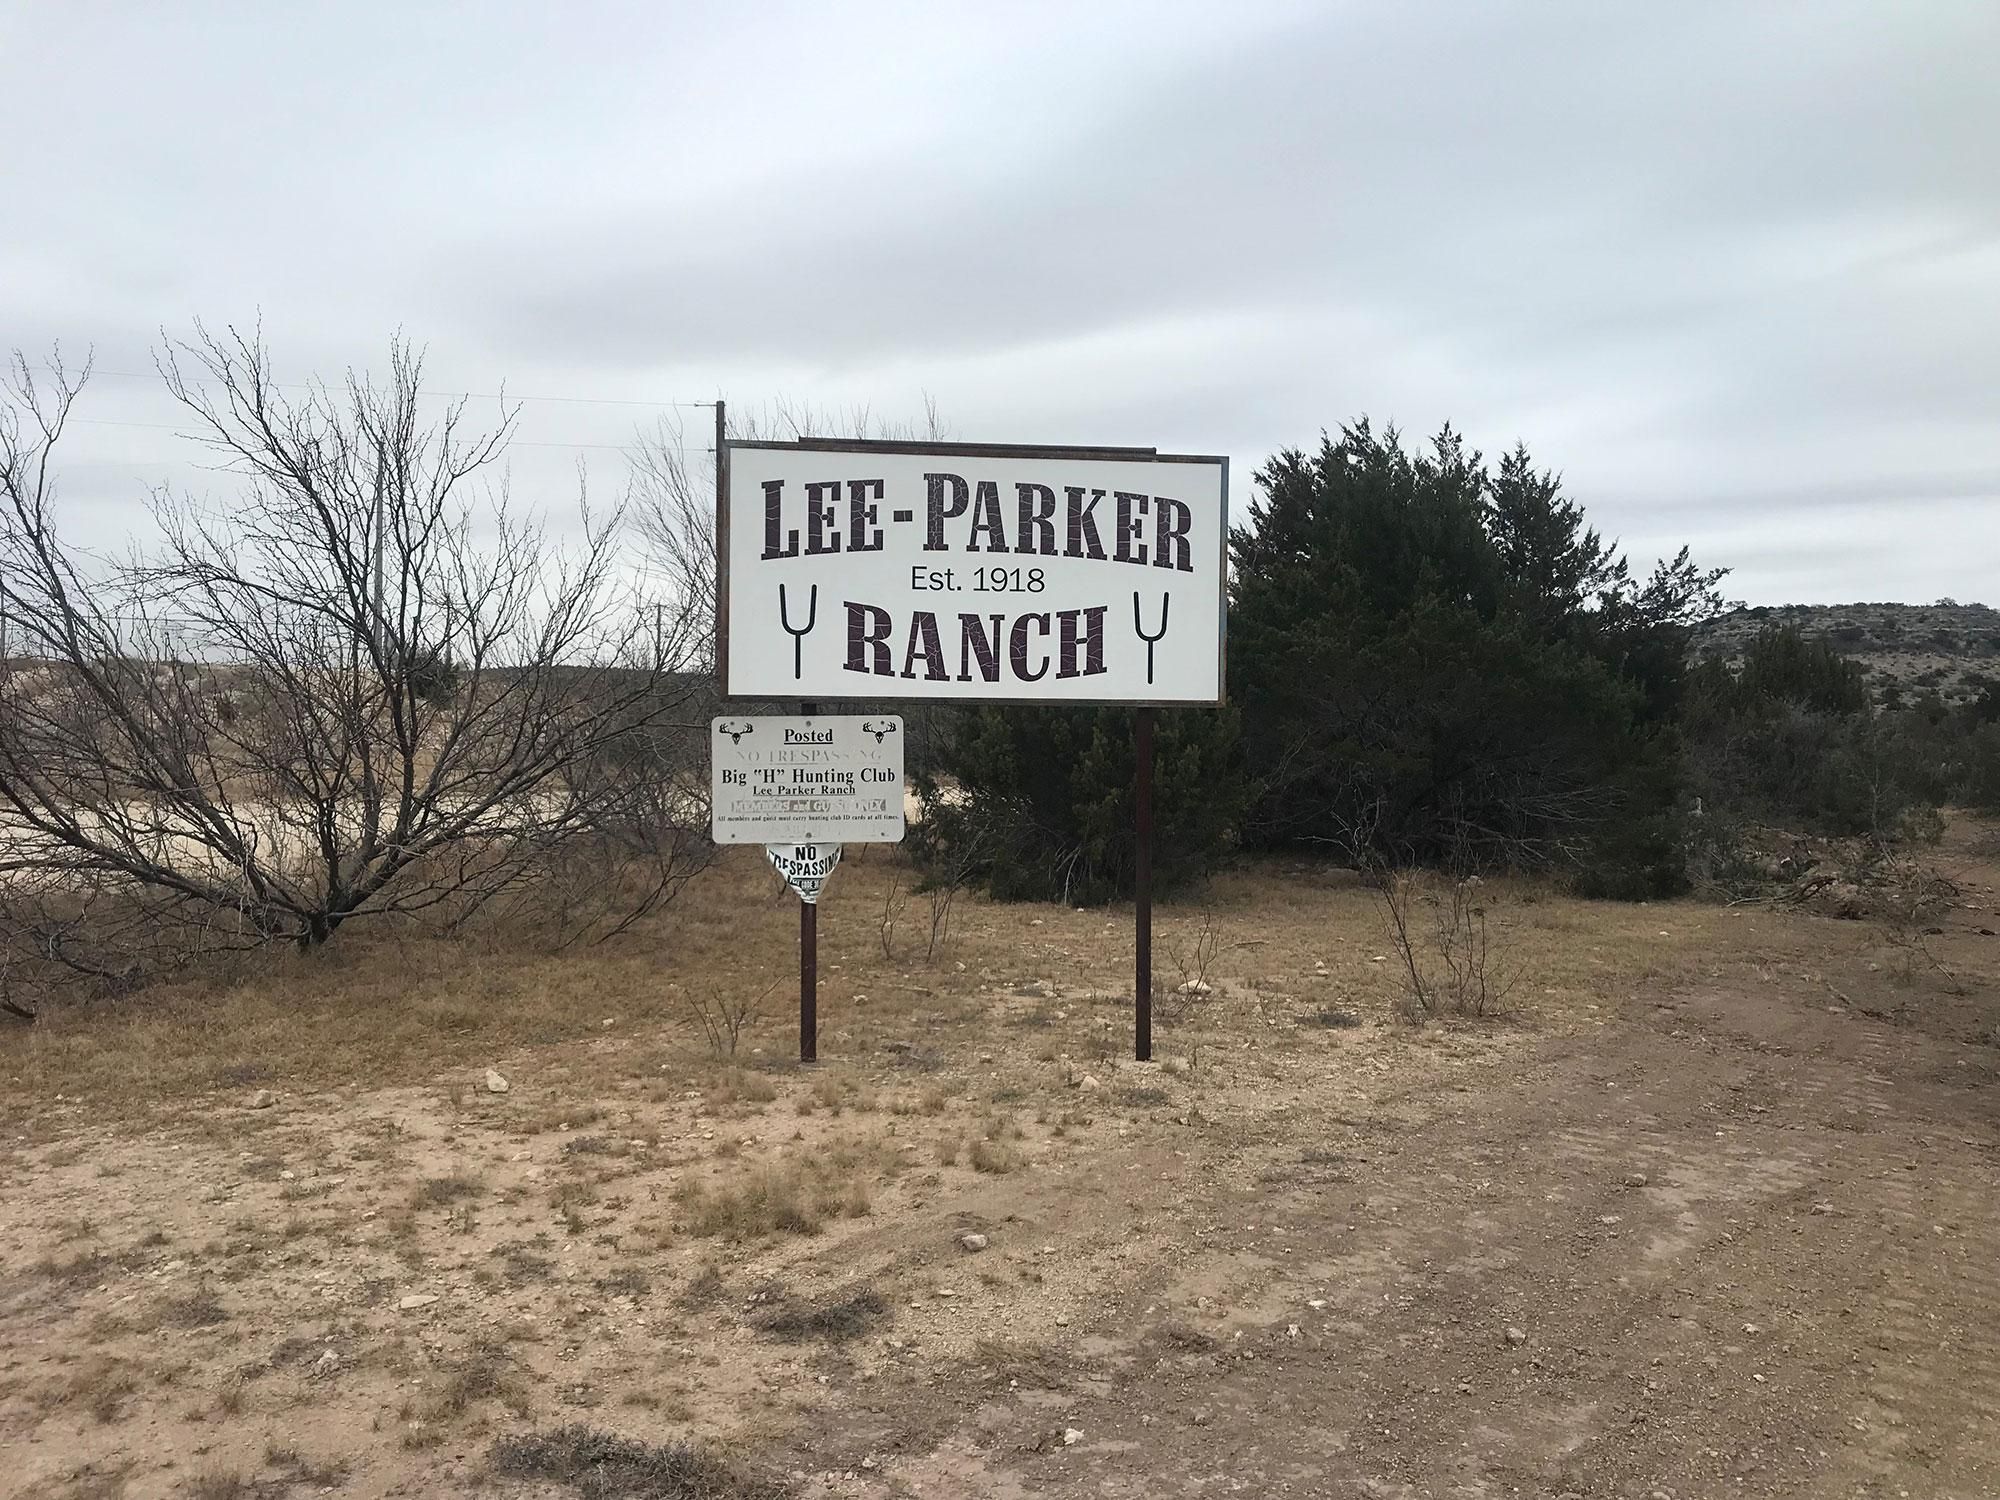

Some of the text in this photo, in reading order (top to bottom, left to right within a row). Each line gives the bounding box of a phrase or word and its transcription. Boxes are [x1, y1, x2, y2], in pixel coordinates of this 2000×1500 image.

[761, 473, 1193, 572] LEE-PARKER
[911, 566, 1045, 593] Est. 1918
[843, 601, 1107, 682] RANCH
[784, 729, 833, 742] Posted
[769, 749, 882, 762] TRESPASSNG
[722, 769, 747, 786] Big
[793, 768, 854, 785] Hunting
[861, 768, 895, 783] Club
[753, 785, 856, 795] Lee Parker Ranch
[796, 847, 816, 861] NO
